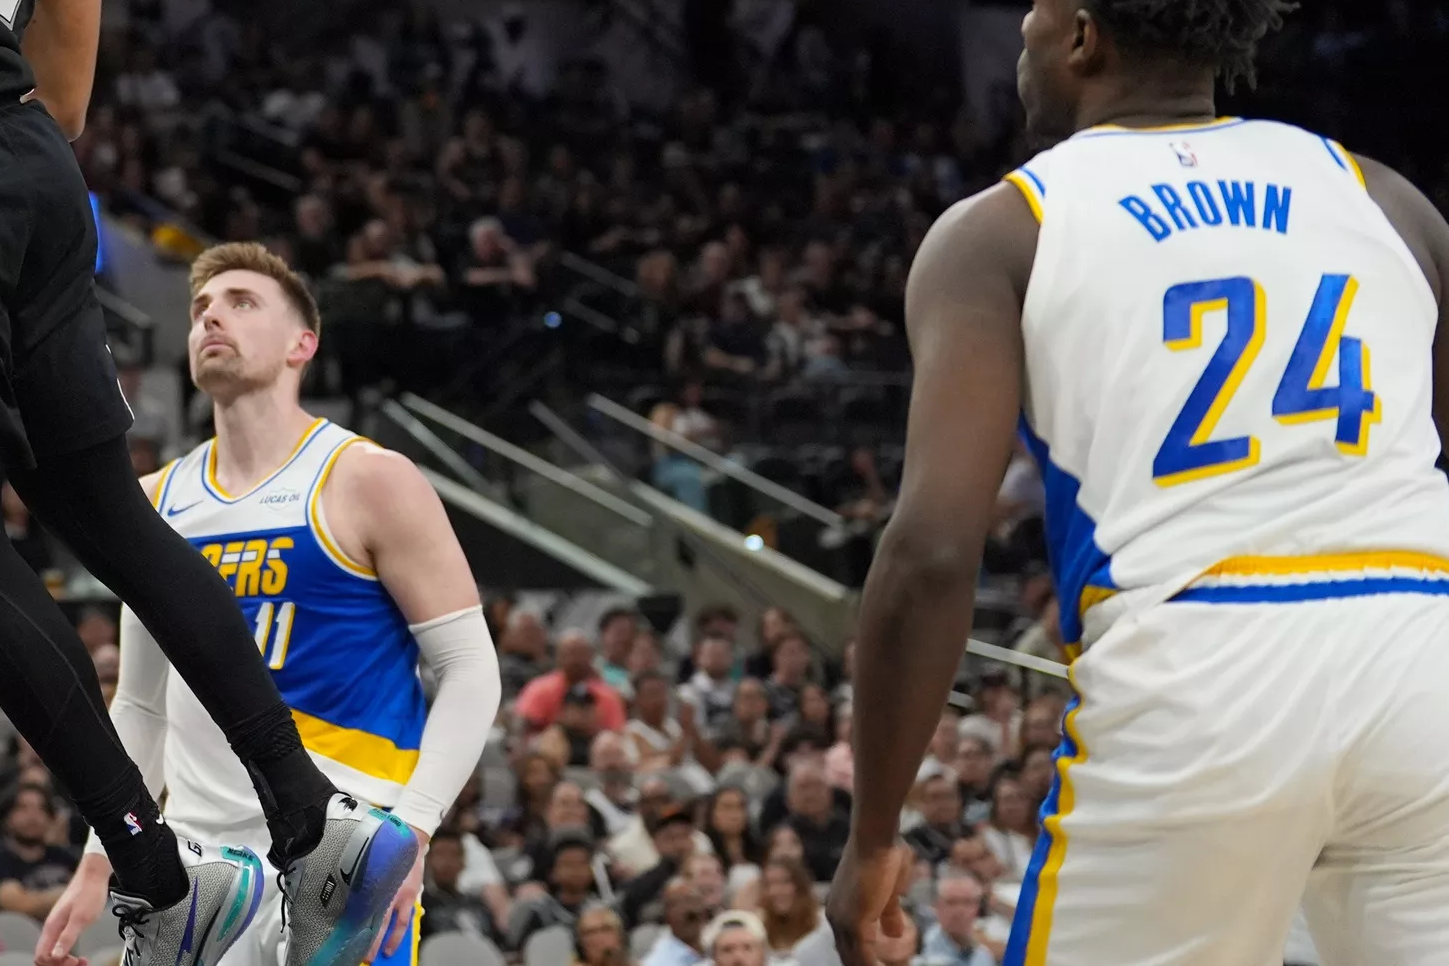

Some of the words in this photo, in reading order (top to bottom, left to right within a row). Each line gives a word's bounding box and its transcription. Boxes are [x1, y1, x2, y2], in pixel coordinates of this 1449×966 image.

[1116, 178, 1293, 244] BROWN
[1151, 270, 1383, 490] 24
[253, 600, 296, 671] 11
